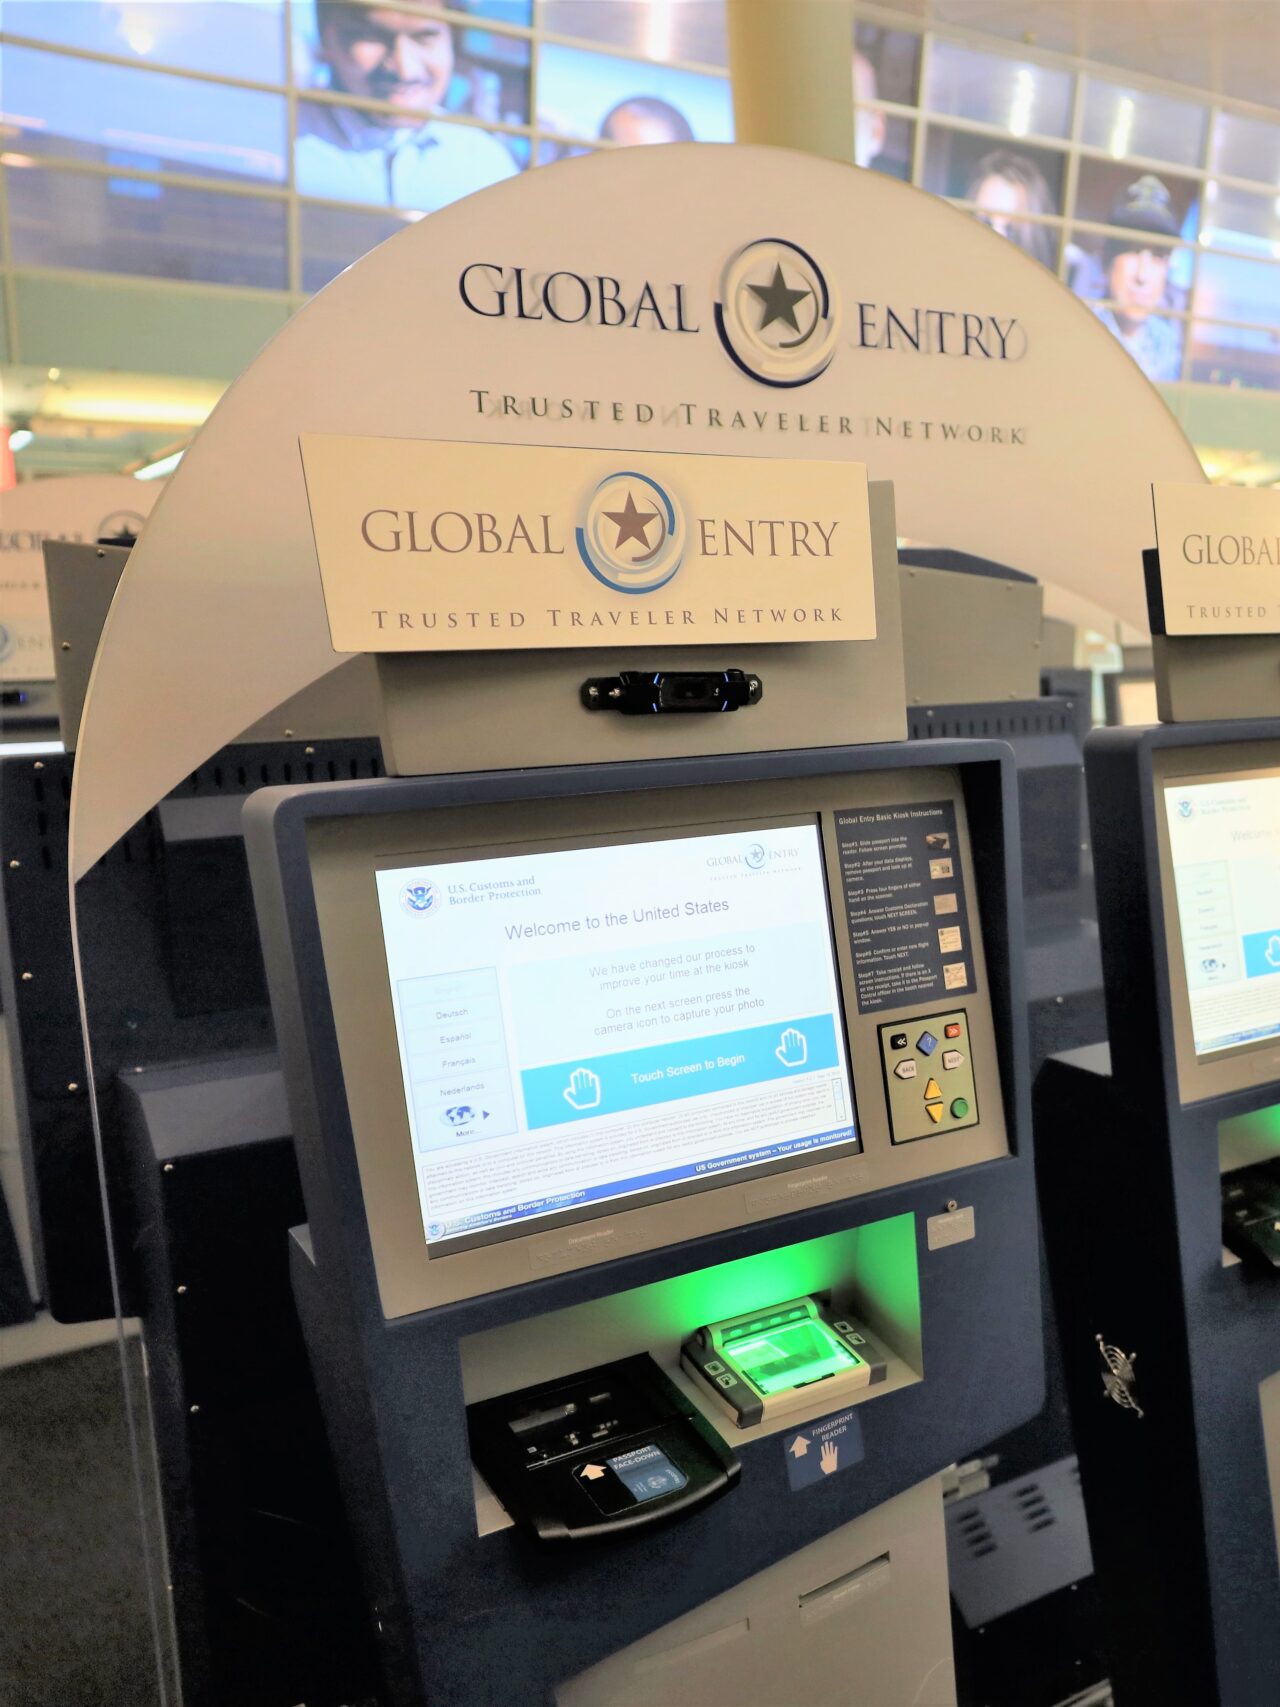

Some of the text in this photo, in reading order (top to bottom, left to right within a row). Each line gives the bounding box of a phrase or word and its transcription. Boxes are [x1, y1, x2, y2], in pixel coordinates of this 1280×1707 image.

[459, 263, 1018, 360] GLOBAL ENTRY
[469, 389, 1025, 445] TRUSTED TRAVELER NETWORK
[361, 509, 841, 558] GLOBAL ENTRY
[372, 607, 843, 629] TRUSTED TRAVELER NETWORK
[1187, 604, 1267, 619] TRUSTED
[838, 809, 943, 824] Global Entry Basic Kiosk Instructions
[448, 876, 536, 894] U.S. Customs and
[449, 886, 542, 906] Border Protection
[504, 899, 730, 940] Welcome to the United States
[589, 944, 755, 977] We have changed our process to
[600, 958, 749, 992] improve your time at the kiosk
[436, 1008, 469, 1020] Deutsch
[606, 986, 750, 1019] On the next screen press the
[594, 999, 764, 1036] camera icon to capture your photo
[440, 1032, 472, 1044] Español
[441, 1057, 476, 1069] Français
[631, 1054, 745, 1084] Touch Screen to Begin
[440, 1082, 485, 1097] Nederlands
[695, 1163, 706, 1172] US
[707, 1154, 748, 1170] Government
[748, 1149, 772, 1162] system
[777, 1144, 792, 1154] Your
[793, 1140, 812, 1151] usage
[813, 1137, 819, 1145] is
[819, 1129, 852, 1143] monitored!
[464, 1210, 502, 1223] Customs
[503, 1206, 516, 1216] and
[517, 1199, 545, 1212] Border
[546, 1190, 586, 1206] Protection
[811, 1412, 853, 1437] FINGERPRINT
[821, 1425, 847, 1442] READER
[612, 1446, 651, 1463] PASSPORT
[613, 1450, 661, 1470] FACE-DOWN
